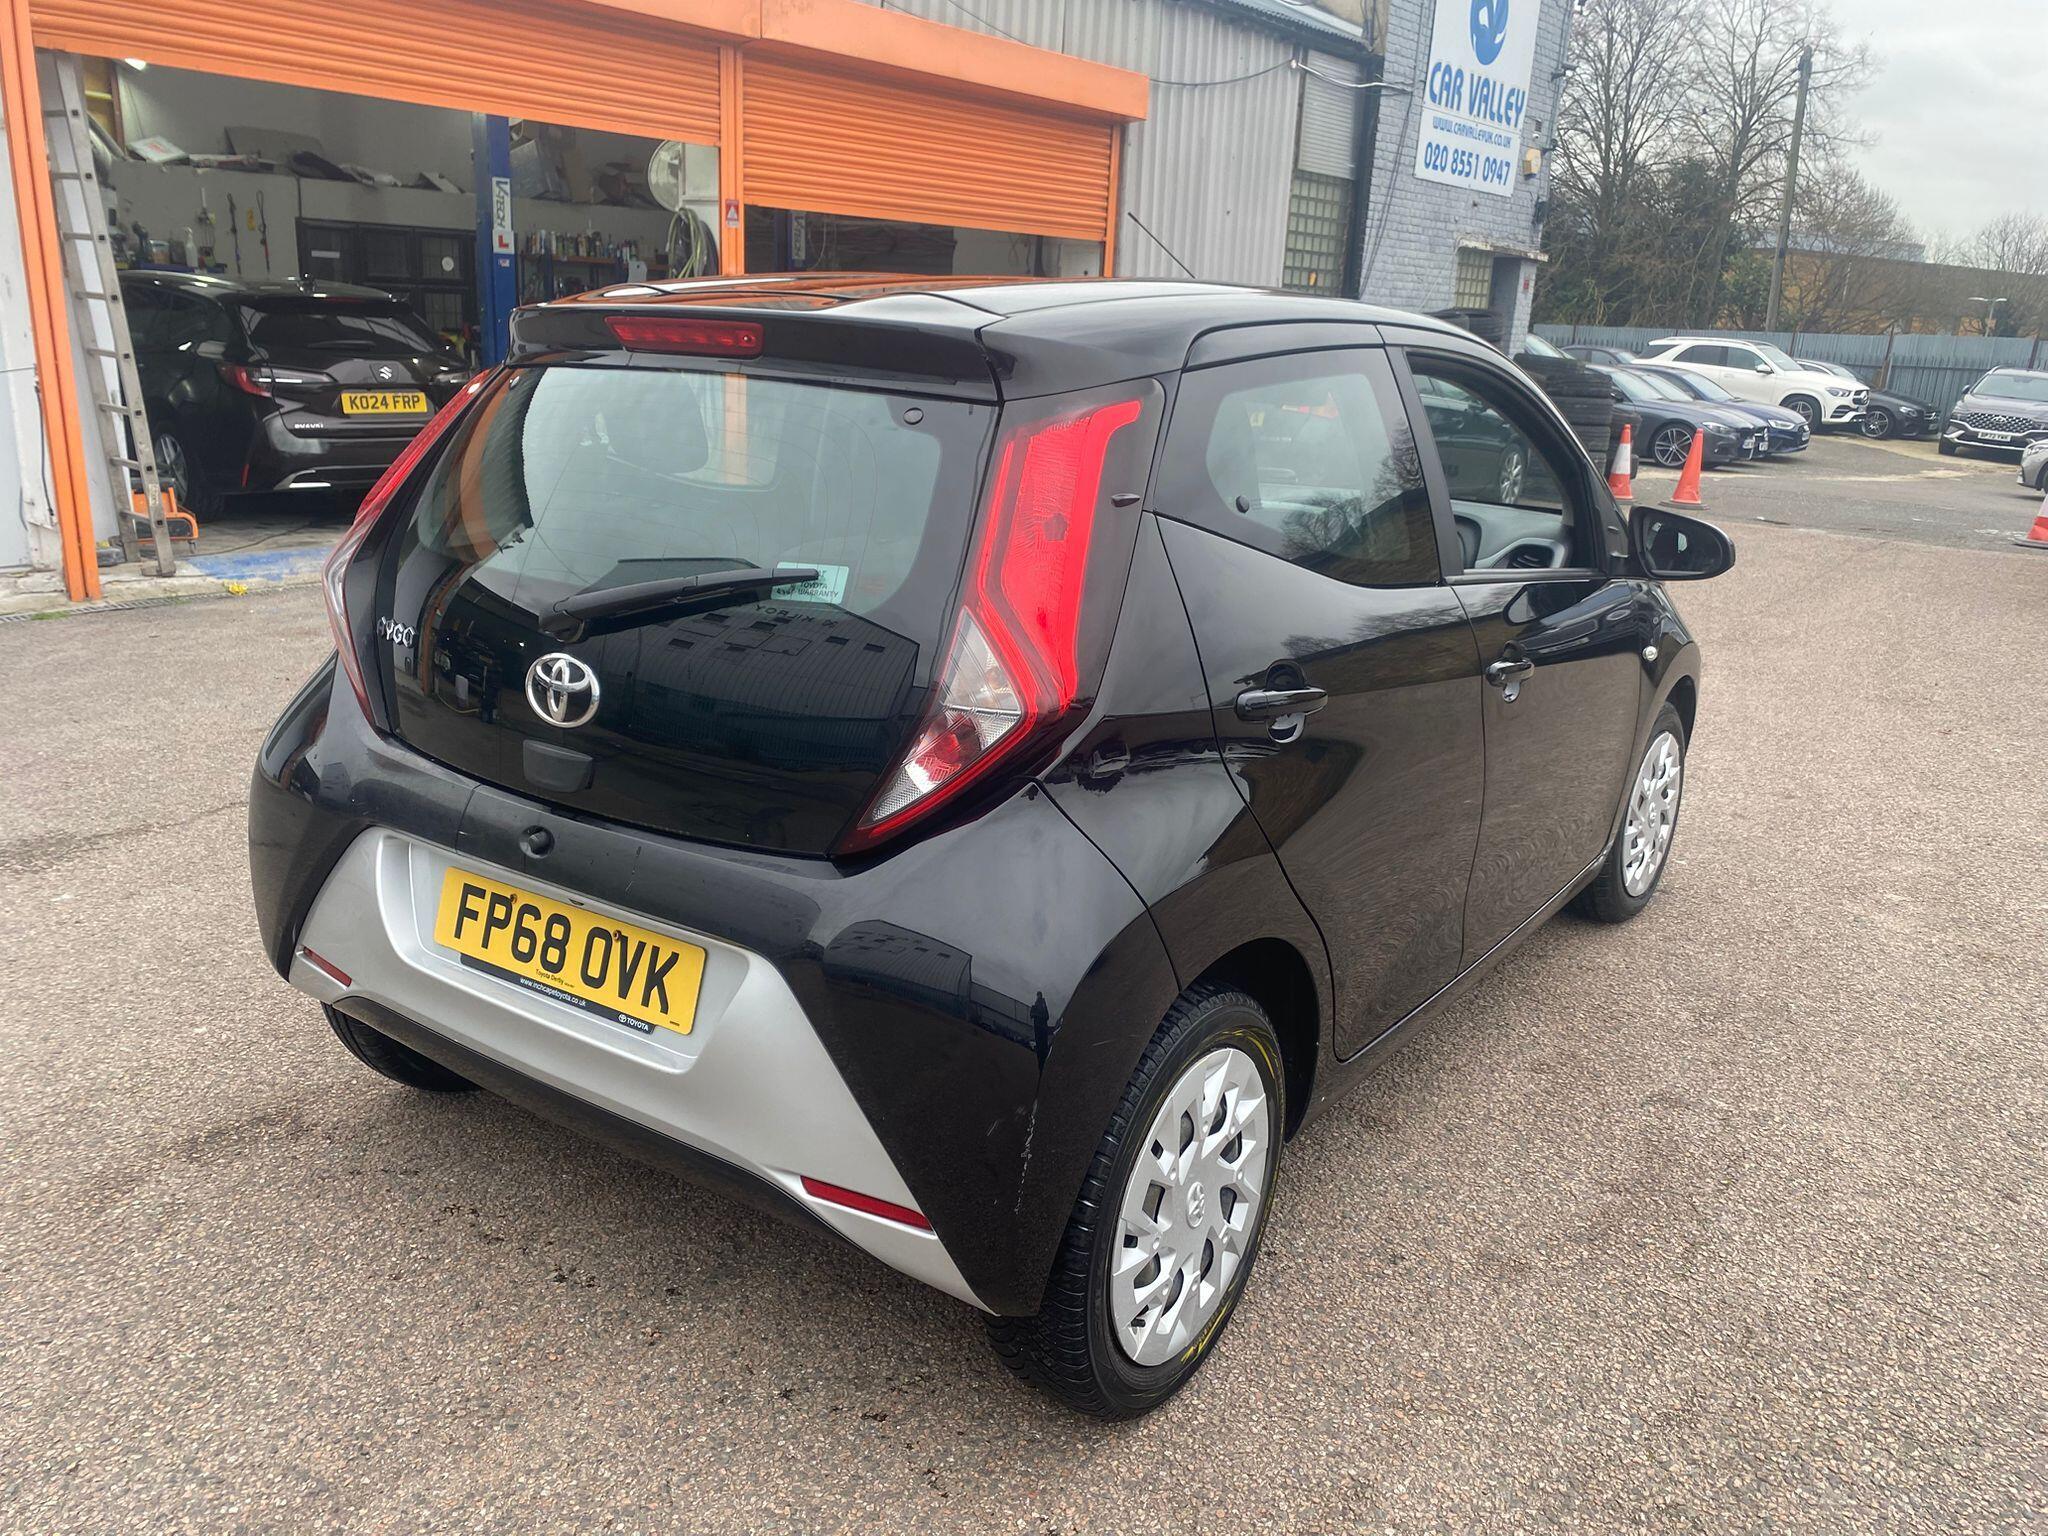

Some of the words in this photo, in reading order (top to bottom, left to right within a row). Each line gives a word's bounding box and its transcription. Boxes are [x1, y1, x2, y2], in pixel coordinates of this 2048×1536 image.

[1429, 62, 1465, 111] CAR
[1468, 73, 1526, 129] VALLEY
[1424, 141, 1448, 173] 020
[1450, 148, 1480, 180] 8551
[1482, 156, 1511, 186] 0947
[392, 395, 421, 410] FRP
[453, 882, 571, 975] FP68
[580, 925, 680, 1015] OVK
[535, 968, 551, 980] Toyota
[550, 974, 564, 986] Derby
[626, 1016, 649, 1032] TOYOTA
